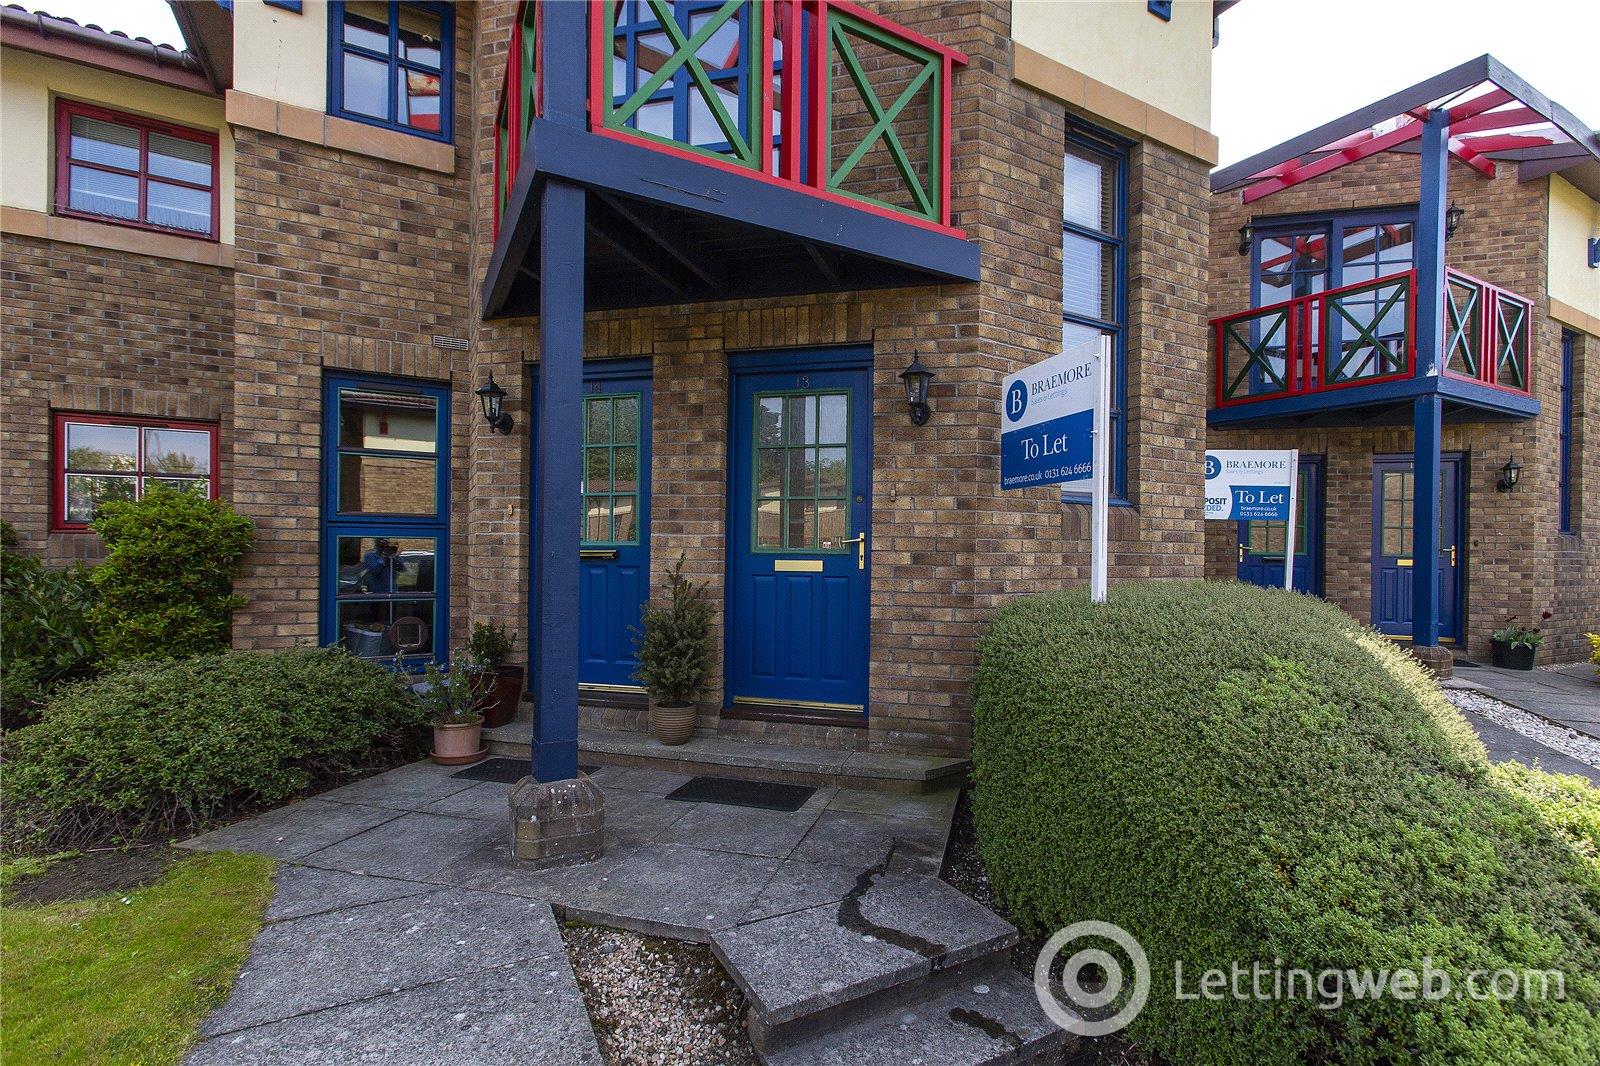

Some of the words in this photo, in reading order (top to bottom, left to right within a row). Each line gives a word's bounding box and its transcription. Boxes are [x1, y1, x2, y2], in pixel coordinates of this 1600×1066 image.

[796, 375, 810, 389] 13
[1031, 362, 1092, 396] BRAEMORE
[1010, 389, 1023, 415] B
[1021, 437, 1039, 460] To
[1042, 433, 1069, 456] Let
[1003, 471, 1043, 486] braemore.co.uk
[1044, 468, 1060, 479] 0131
[1060, 465, 1073, 476] 624
[1073, 461, 1092, 474] 6666
[1226, 460, 1286, 469] BRAEMORE
[1235, 490, 1255, 504] To
[1259, 490, 1284, 504] Let
